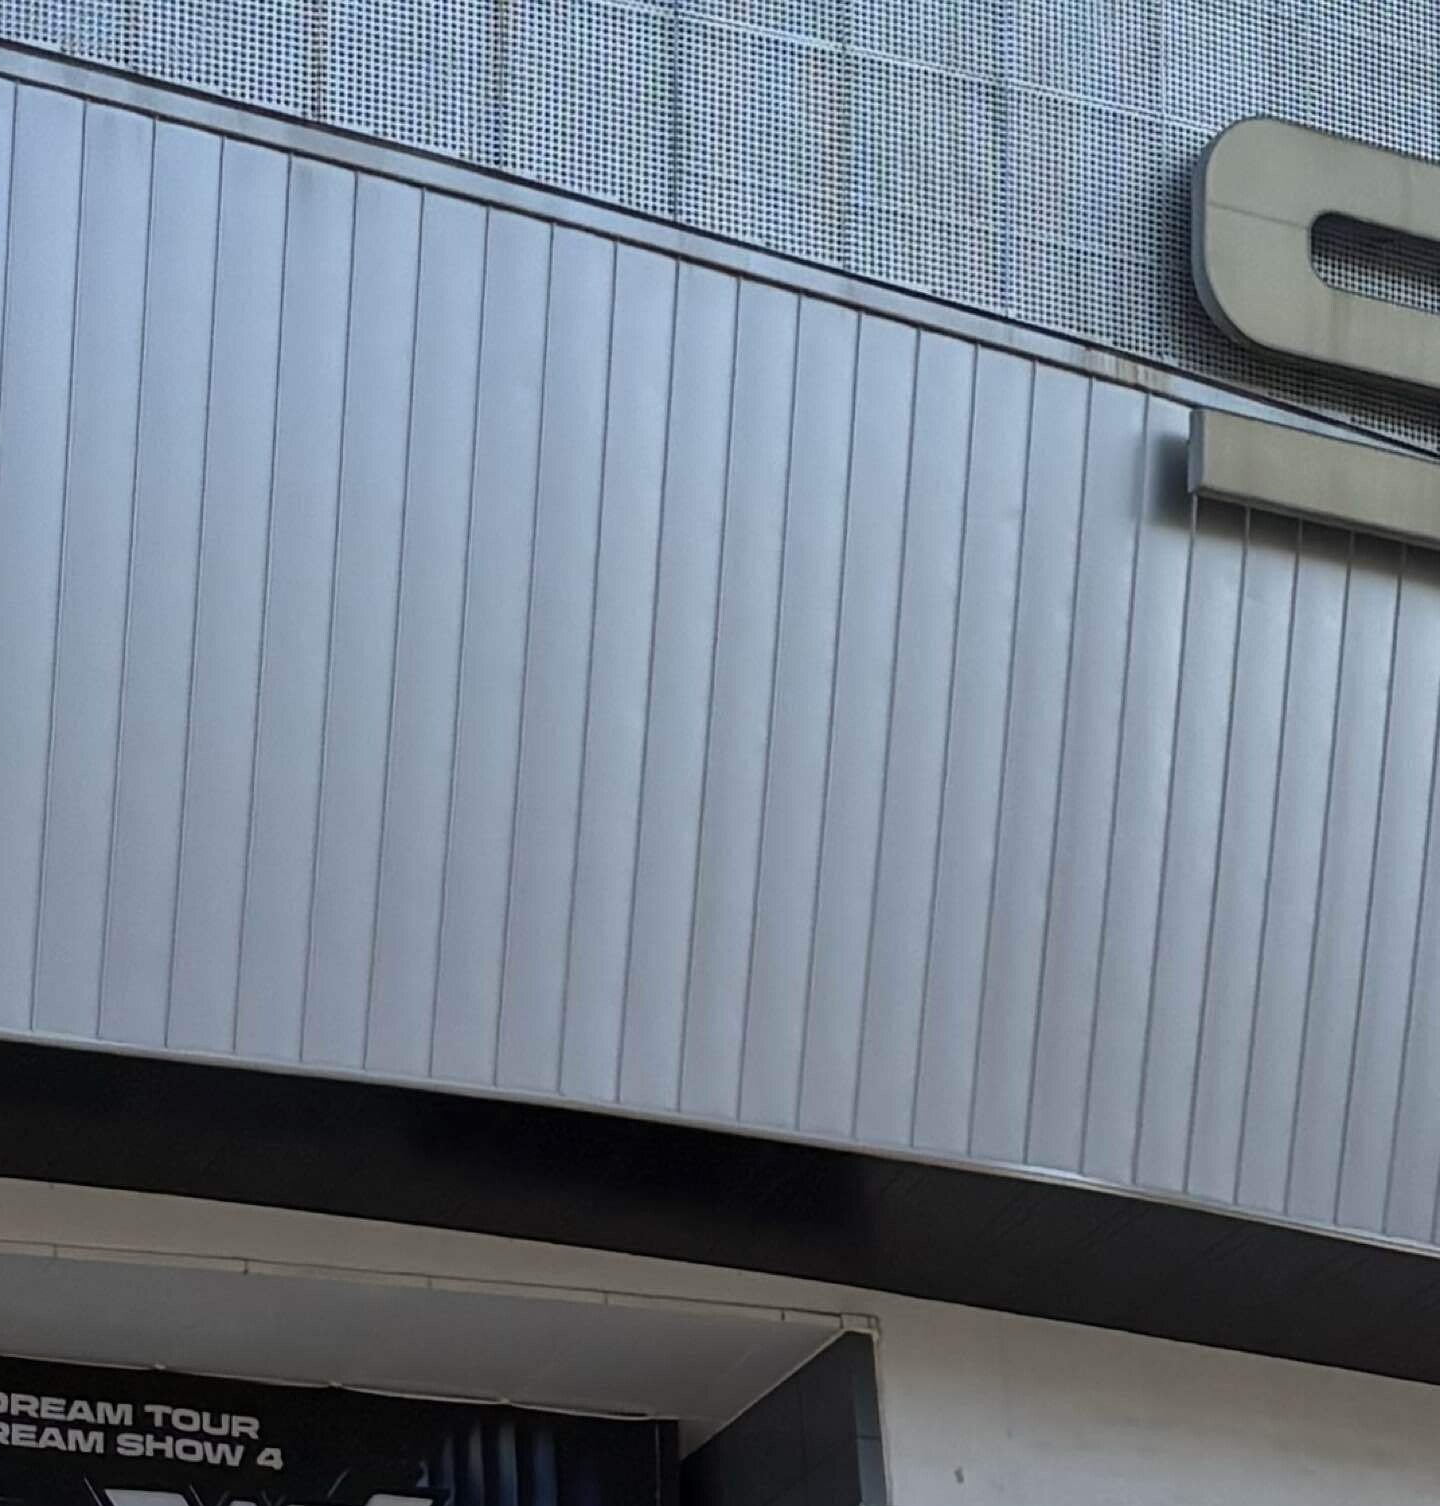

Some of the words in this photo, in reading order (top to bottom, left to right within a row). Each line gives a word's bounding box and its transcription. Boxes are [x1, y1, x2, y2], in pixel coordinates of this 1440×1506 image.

[144, 1403, 261, 1439] TOUR
[116, 1433, 244, 1468] SHOW
[254, 1447, 284, 1471] 4
